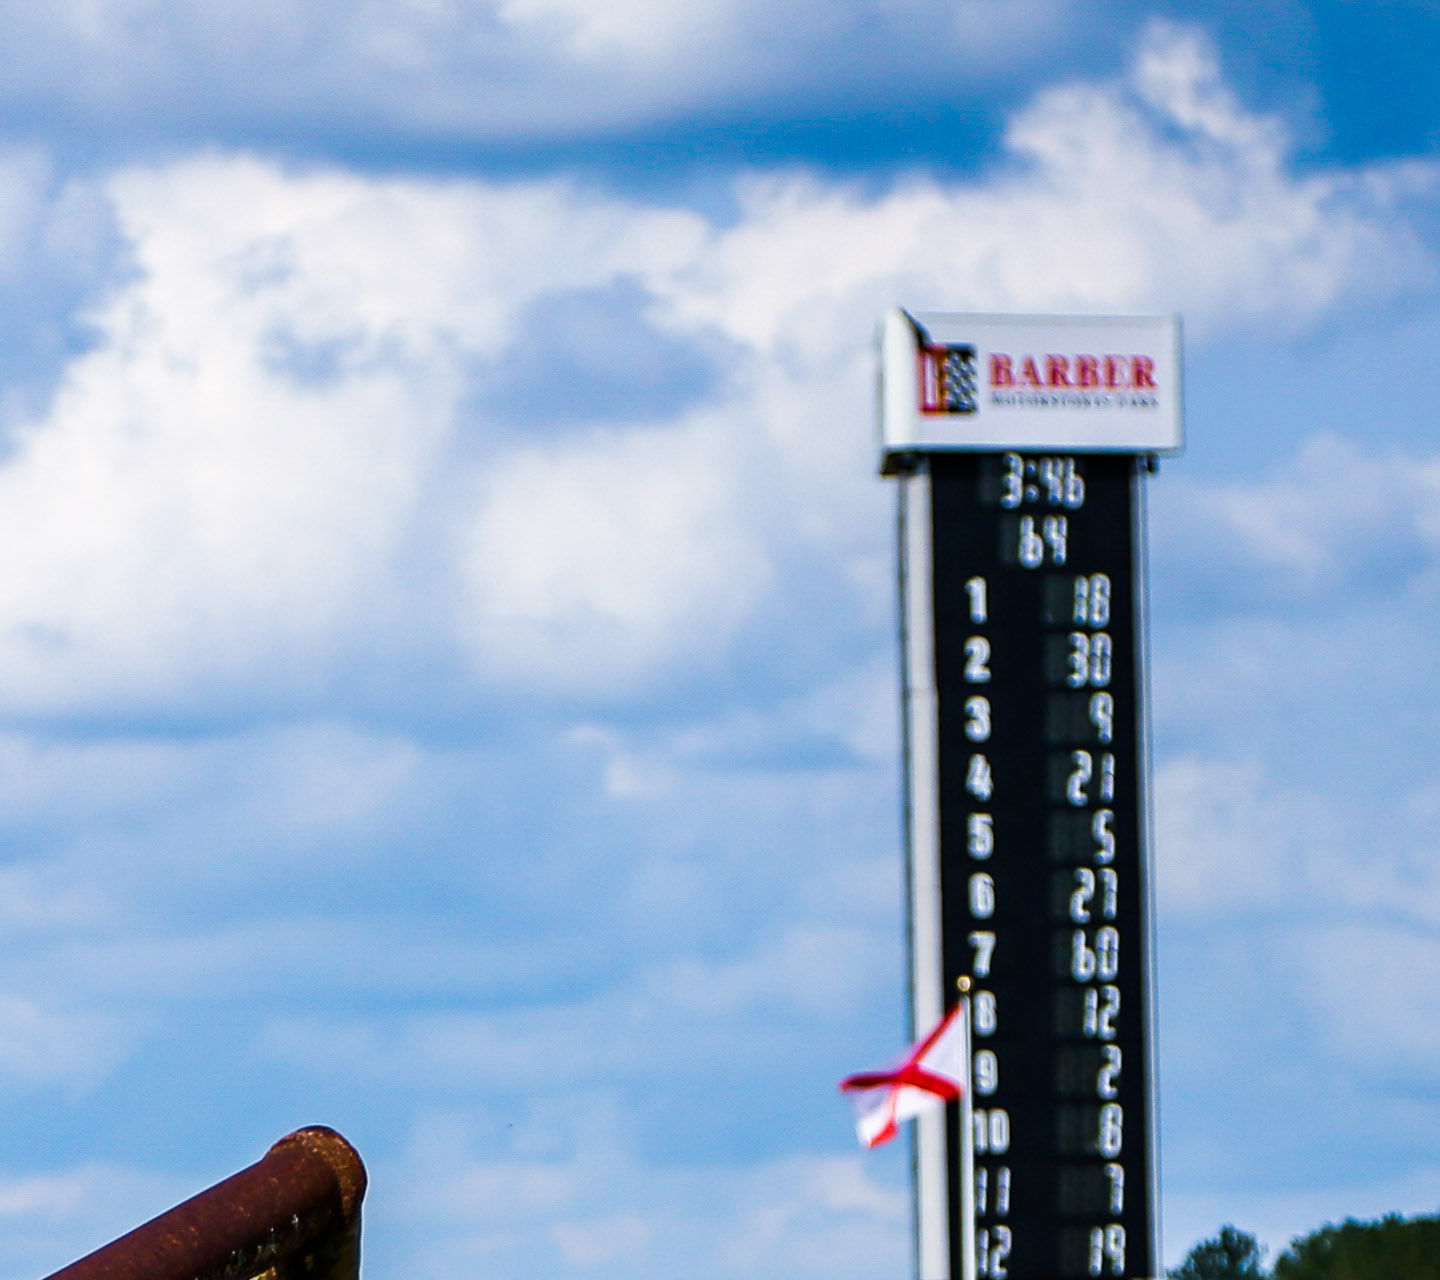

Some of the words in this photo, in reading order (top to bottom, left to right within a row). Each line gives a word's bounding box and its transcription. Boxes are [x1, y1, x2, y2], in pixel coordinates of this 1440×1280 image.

[989, 353, 1158, 390] BARBER
[1001, 451, 1085, 509] 3:46
[1019, 515, 1068, 569] 64
[965, 576, 987, 624] 1
[1073, 572, 1111, 629] 18
[964, 635, 991, 683] 2
[1066, 631, 1113, 688] 30
[964, 695, 991, 742] 3
[1089, 691, 1114, 745] 9
[965, 754, 993, 801] 4
[1066, 750, 1115, 806] 21
[967, 812, 994, 860] 5
[1092, 808, 1115, 864] 5
[969, 872, 995, 920] 6
[968, 930, 996, 978] 7
[1072, 926, 1119, 982] 60
[973, 990, 997, 1036] 8
[1083, 985, 1121, 1040] 12
[974, 1049, 998, 1096] 9
[1097, 1044, 1122, 1099] 2
[973, 1107, 1010, 1155] 10
[1099, 1103, 1123, 1159] 8
[975, 1166, 1011, 1216] 11
[977, 1225, 1012, 1280] 12
[1089, 1223, 1126, 1277] 19
